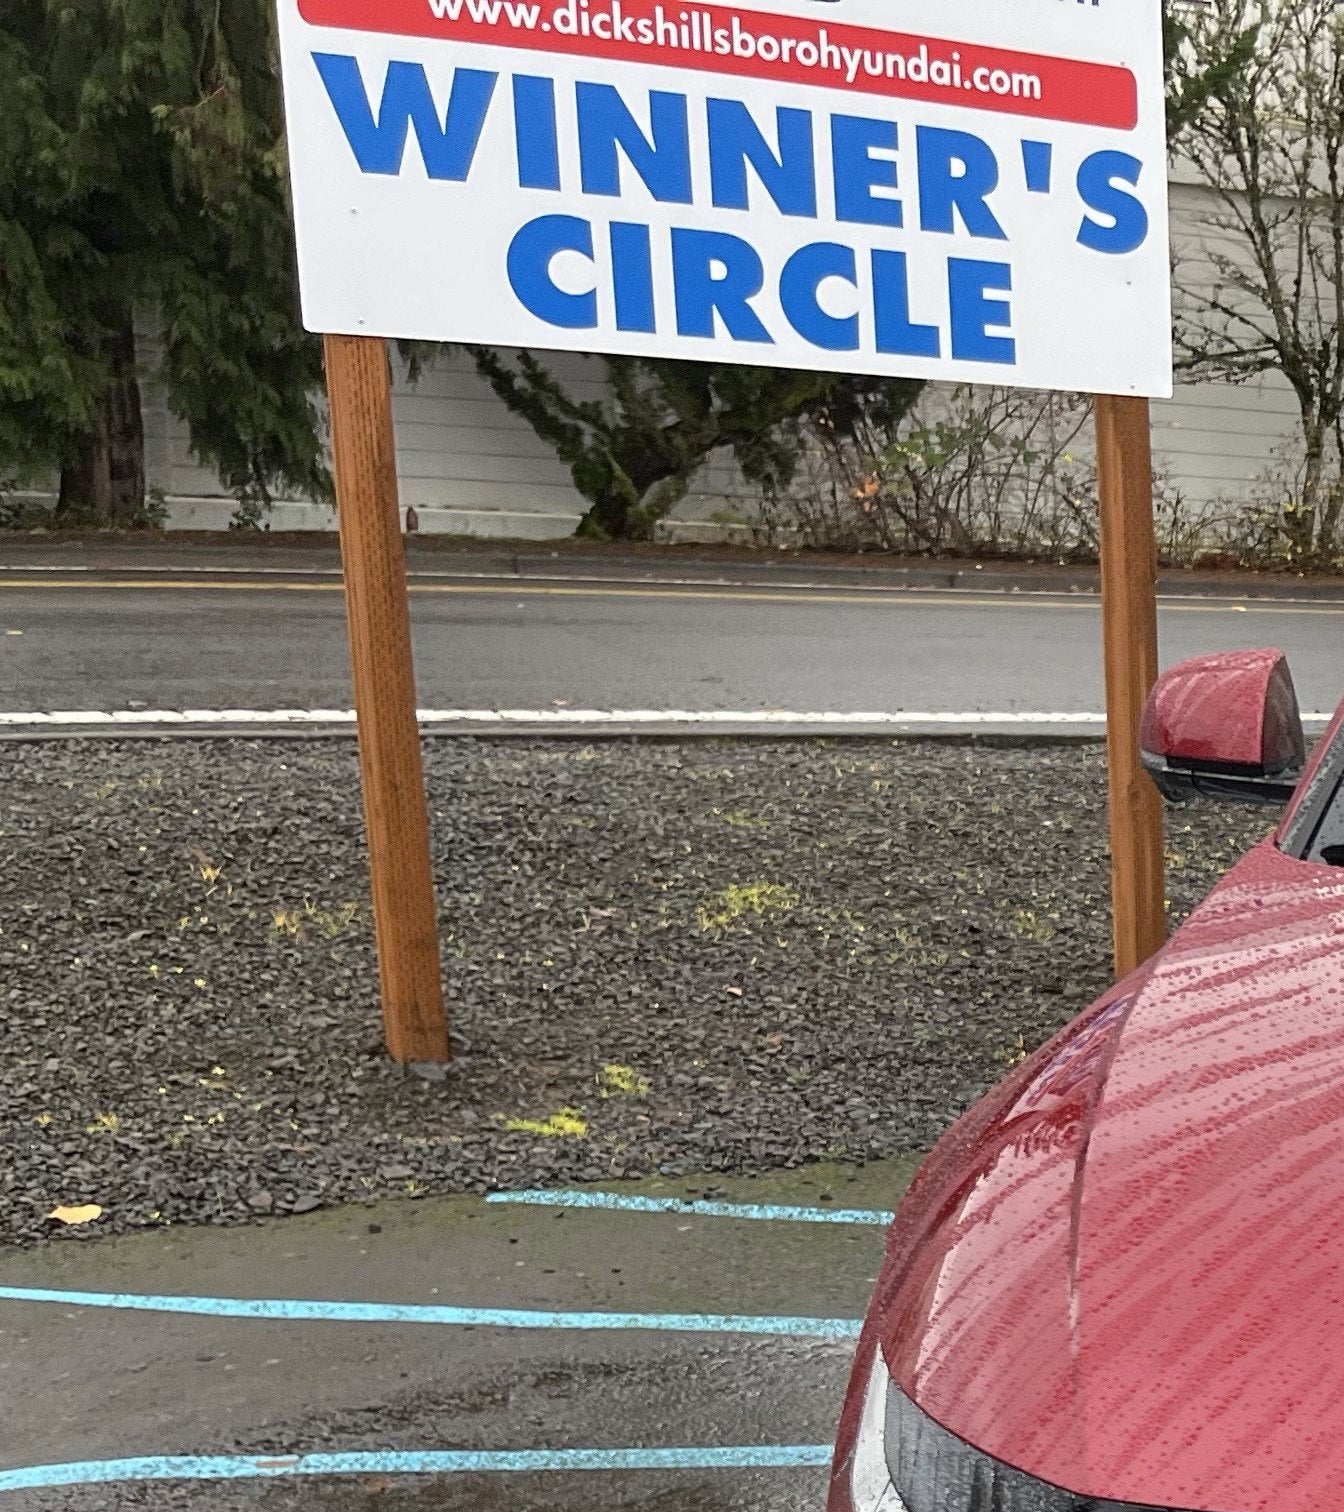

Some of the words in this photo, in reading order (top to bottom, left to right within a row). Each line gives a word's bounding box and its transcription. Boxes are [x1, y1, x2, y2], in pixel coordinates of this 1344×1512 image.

[426, 0, 1043, 100] www.dickshillsborohyundai.com
[310, 52, 1148, 254] WINNER'S
[506, 213, 1017, 366] CIRCLE
